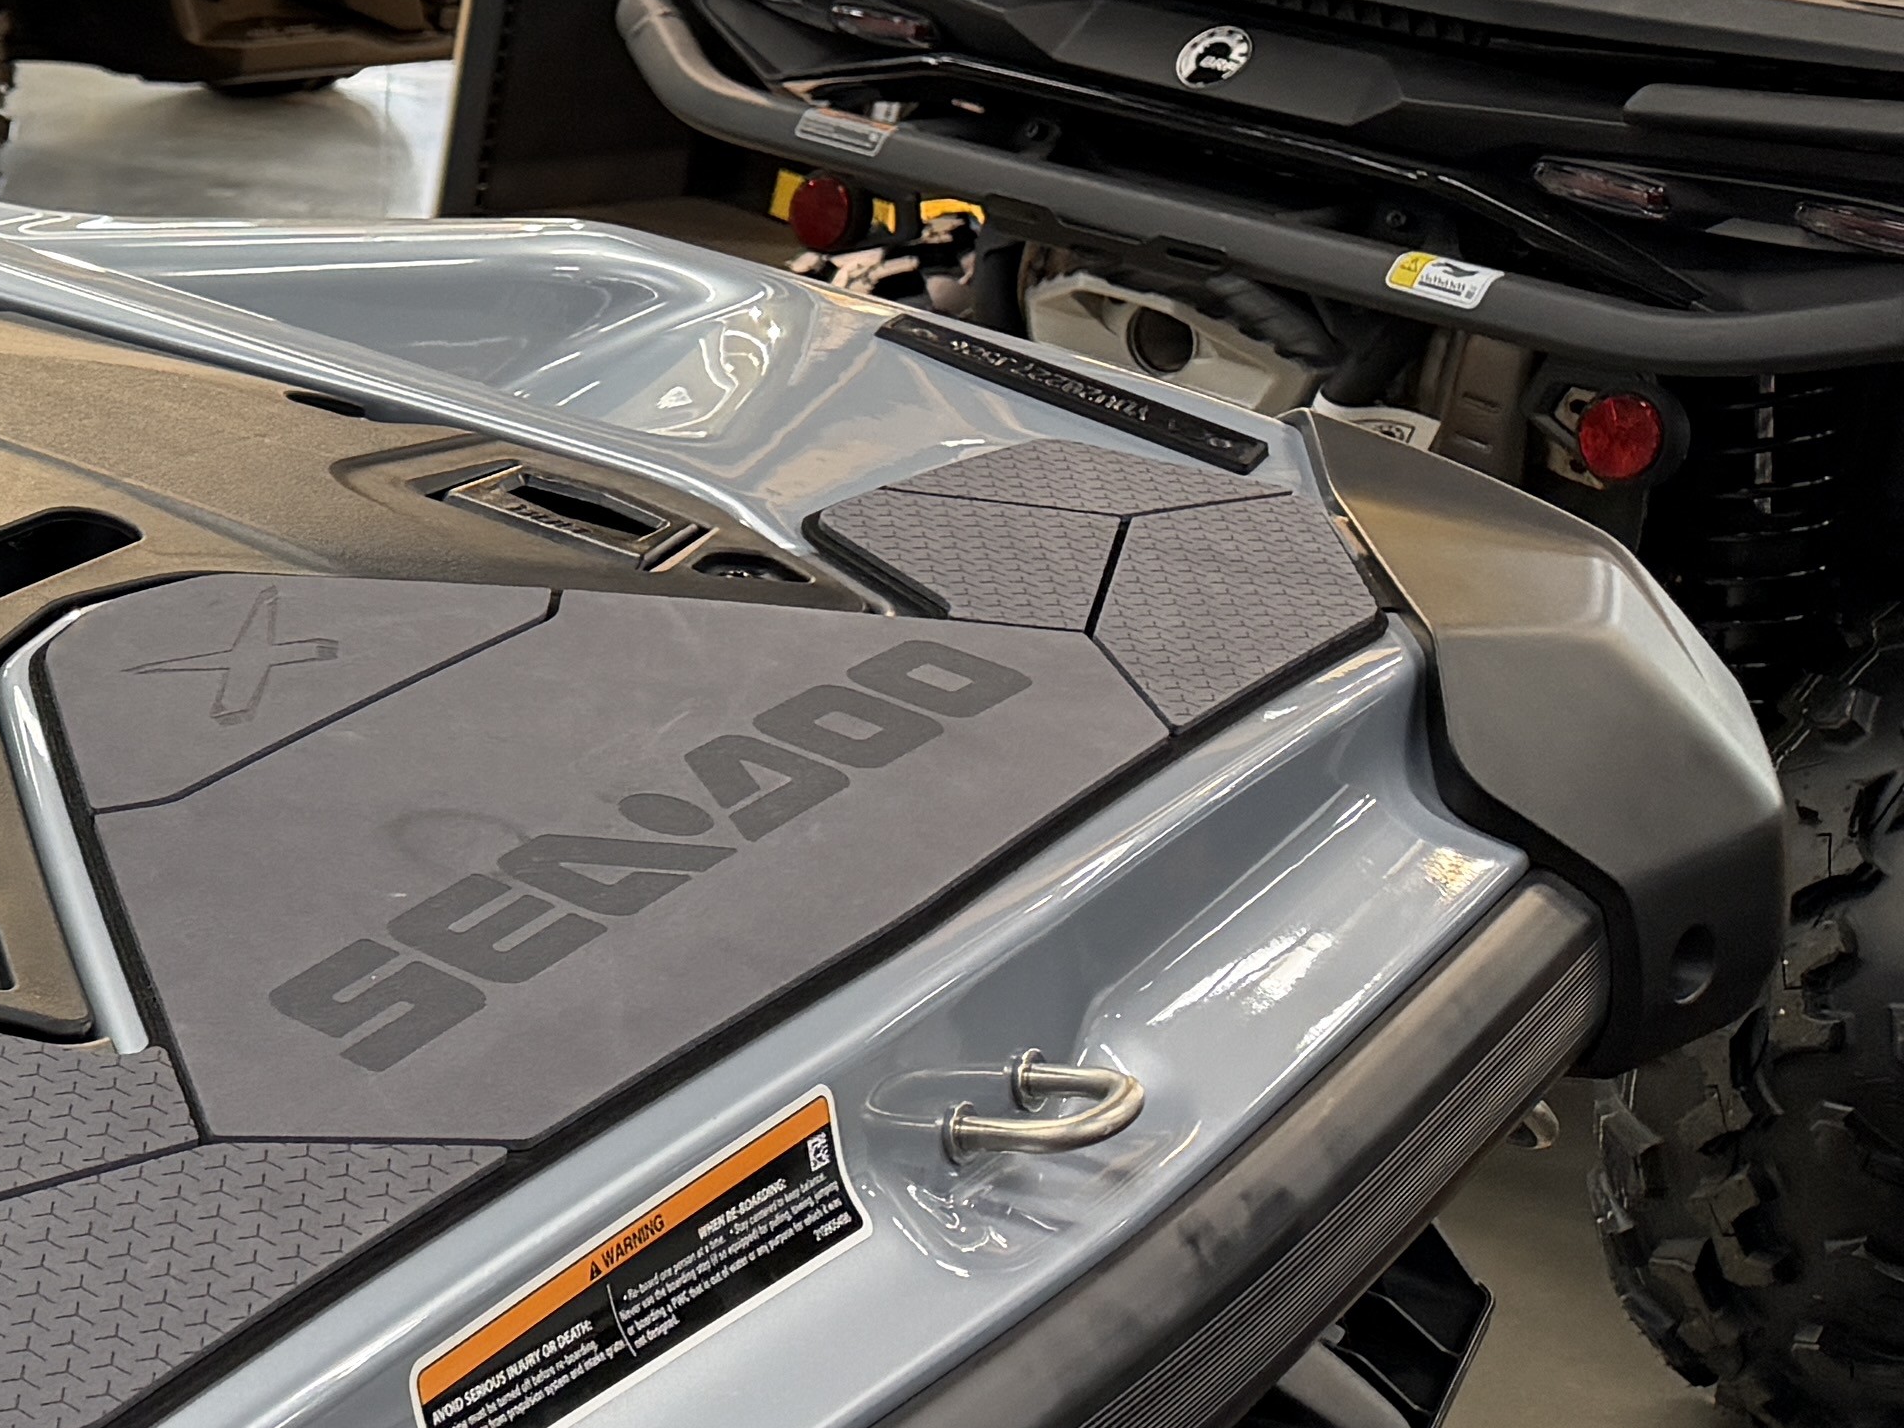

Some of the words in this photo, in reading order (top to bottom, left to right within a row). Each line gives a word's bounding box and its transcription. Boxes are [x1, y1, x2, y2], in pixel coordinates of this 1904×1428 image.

[601, 1214, 665, 1268] WARNING
[432, 1397, 464, 1425] AVOID
[464, 1371, 507, 1406] SERIOUS
[506, 1349, 541, 1380] INJURY
[541, 1340, 558, 1358] OR
[556, 1320, 593, 1349] DEATH:
